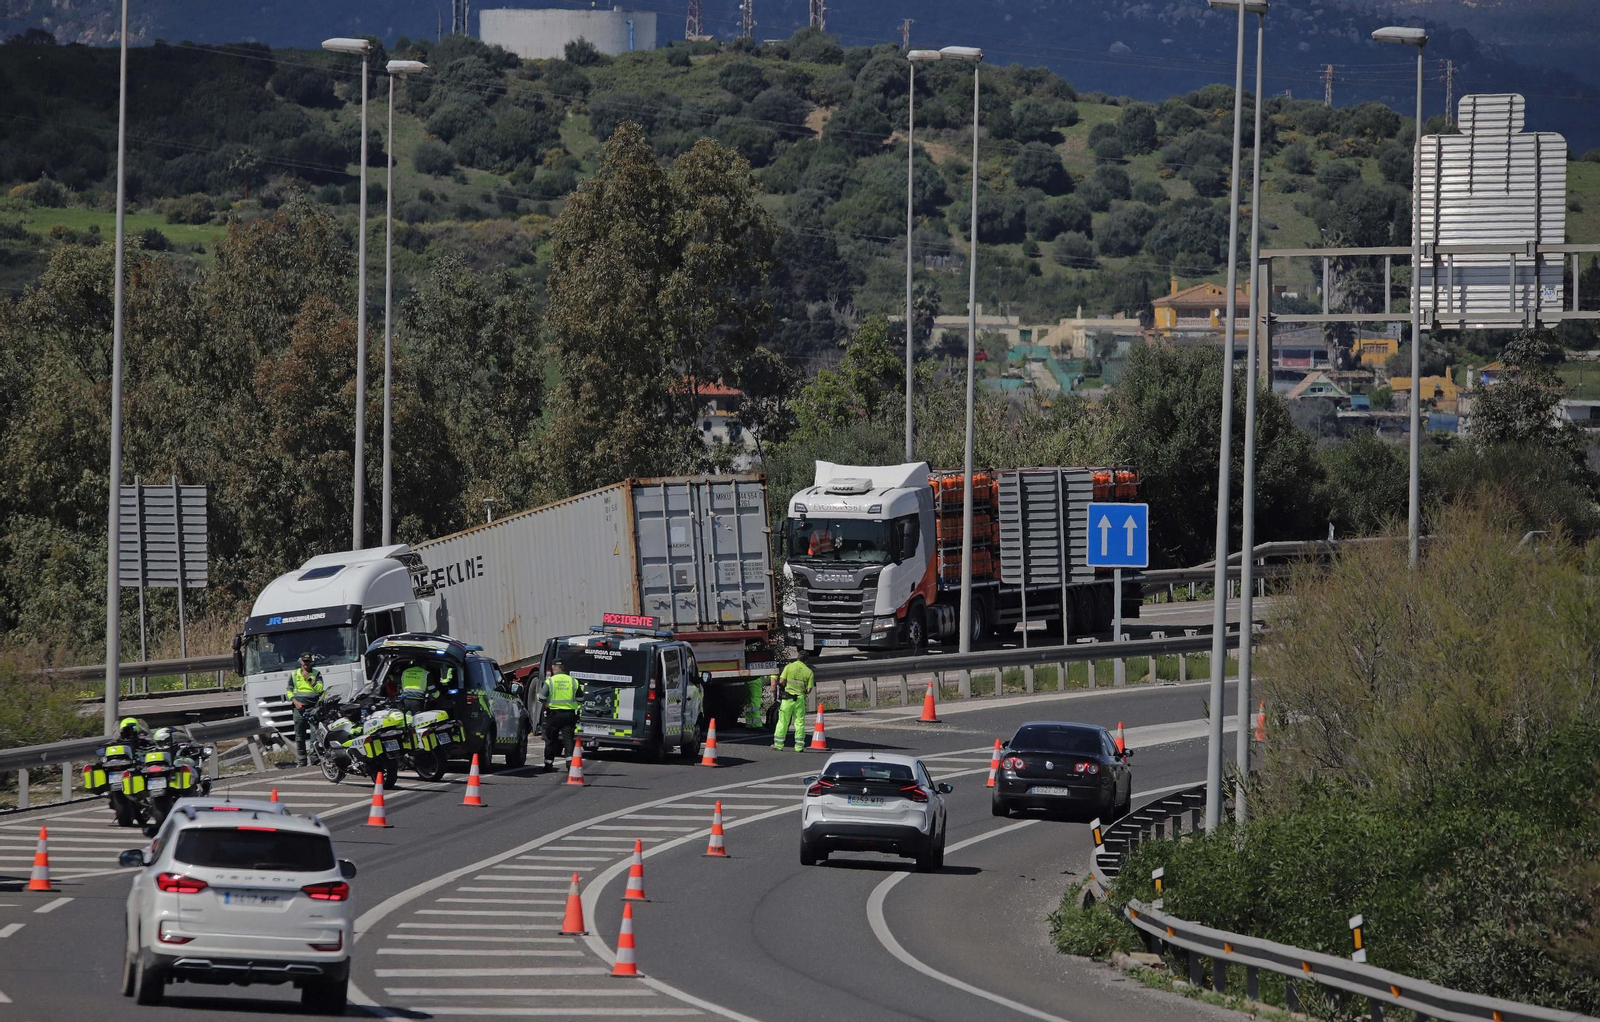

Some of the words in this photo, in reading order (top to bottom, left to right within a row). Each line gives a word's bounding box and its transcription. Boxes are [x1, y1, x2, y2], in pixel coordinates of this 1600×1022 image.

[815, 574, 855, 582] SCANIA
[604, 613, 654, 627] ACCIDENTE
[852, 796, 869, 804] 6252
[216, 874, 296, 882] REXTON
